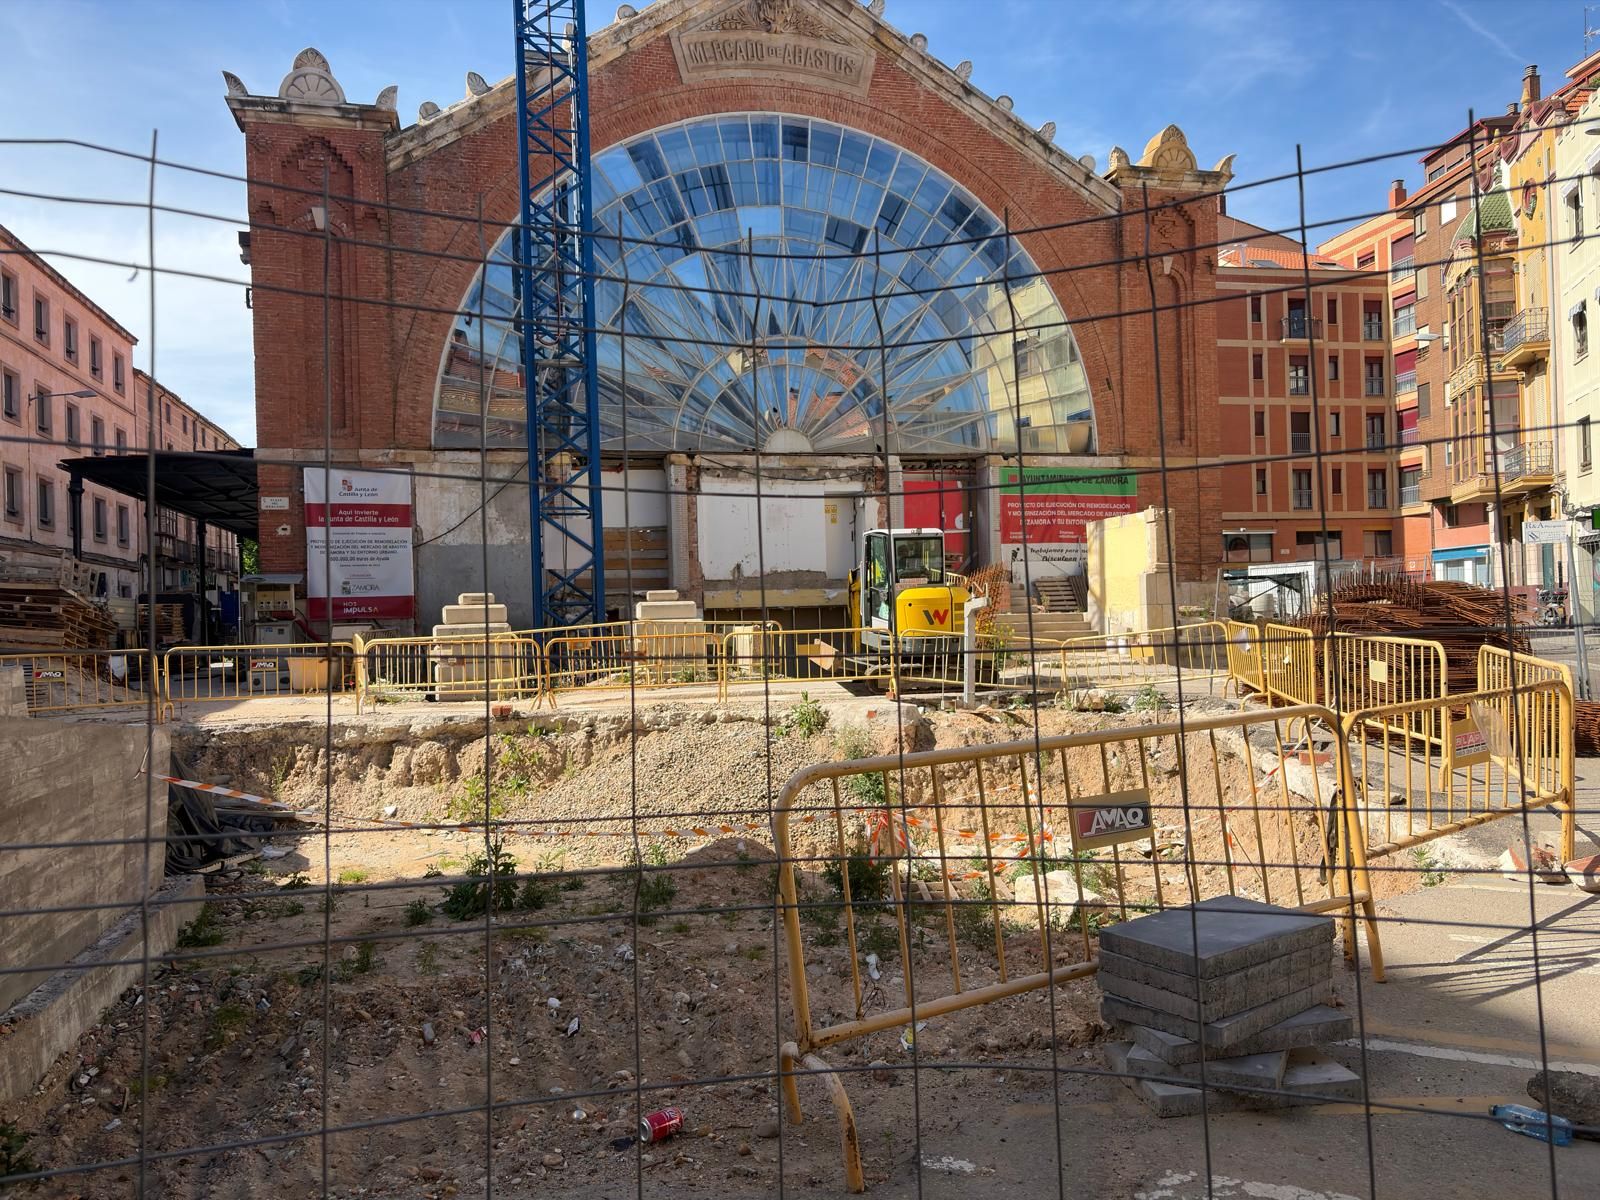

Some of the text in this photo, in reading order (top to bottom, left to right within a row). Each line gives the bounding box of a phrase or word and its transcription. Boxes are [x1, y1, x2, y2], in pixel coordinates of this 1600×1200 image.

[687, 39, 856, 76] MERCADO DE ABASTOS
[1087, 502, 1130, 510] REMODELACIÓN
[383, 515, 399, 523] León
[343, 606, 379, 614] IMPULSA
[1083, 807, 1145, 836] AMAQ
